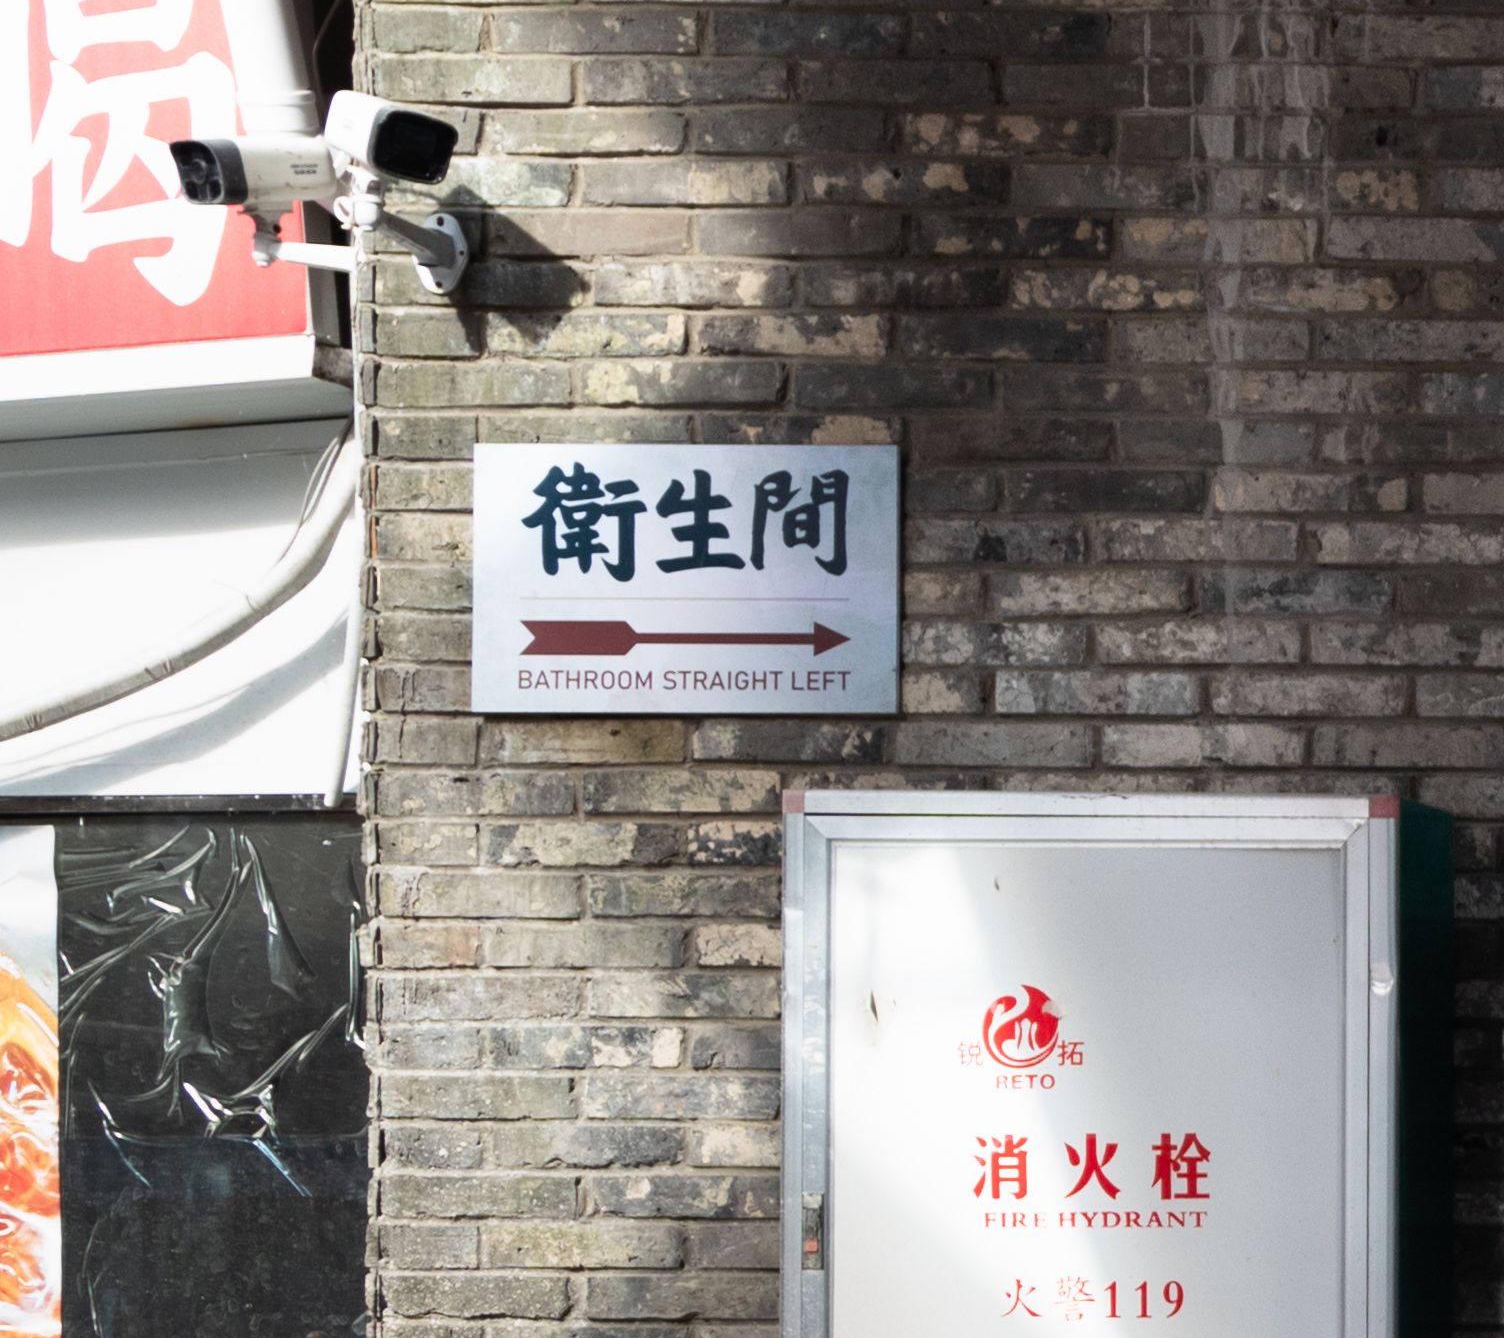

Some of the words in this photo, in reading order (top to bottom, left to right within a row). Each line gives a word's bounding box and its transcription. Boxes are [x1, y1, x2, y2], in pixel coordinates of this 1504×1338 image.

[521, 461, 850, 582] 衛生間
[518, 670, 653, 690] BATHROOM
[663, 671, 782, 691] STRAIGHT
[791, 671, 851, 691] LEFT
[996, 1073, 1056, 1089] RETO
[973, 1133, 1211, 1200] 消火栓
[984, 1212, 1048, 1228] FIRE
[1059, 1211, 1208, 1228] HYDRANT
